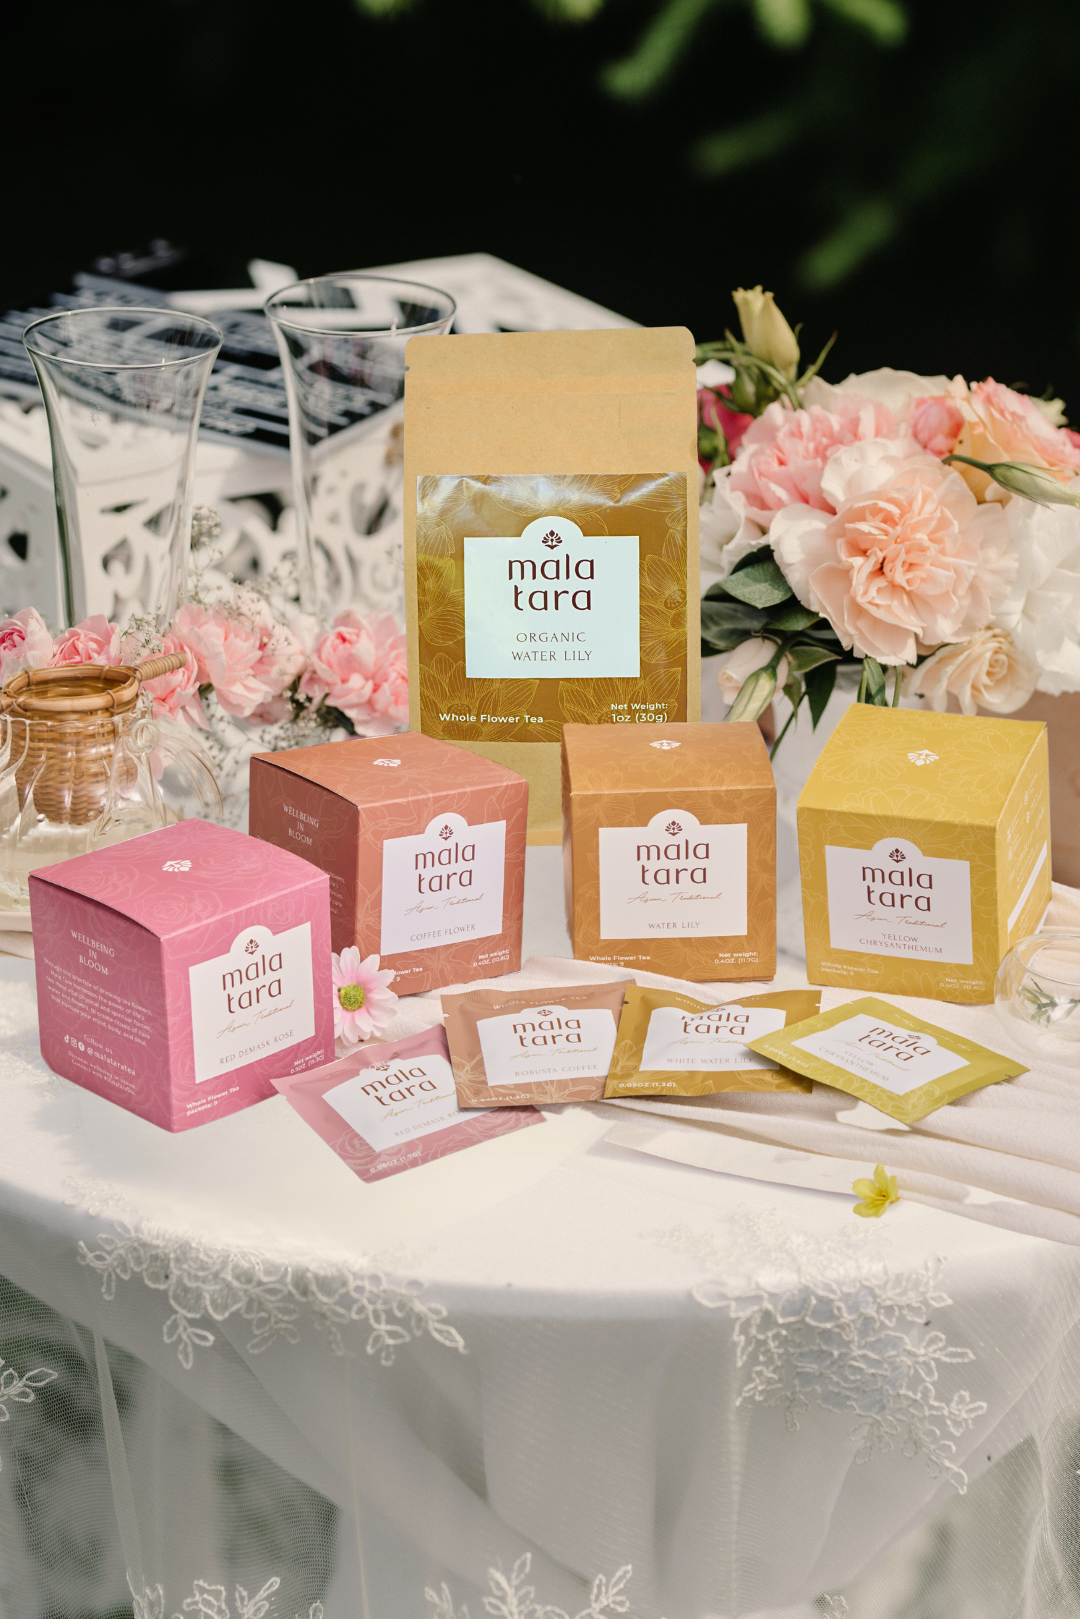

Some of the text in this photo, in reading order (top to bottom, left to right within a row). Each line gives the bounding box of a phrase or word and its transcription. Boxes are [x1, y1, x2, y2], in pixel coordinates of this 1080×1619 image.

[508, 554, 594, 580] mala
[513, 585, 592, 611] tara
[516, 632, 586, 643] ORGANIC
[511, 650, 593, 661] WATER LILY
[631, 702, 668, 711] Weight:
[439, 713, 544, 723] Whole Flower Tea
[611, 712, 668, 723] 1oz (30g)
[283, 803, 319, 828] WELLBEING
[297, 821, 305, 832] IN
[288, 828, 313, 846] BLOOM
[415, 842, 476, 870] mala
[636, 838, 710, 862] mala
[418, 869, 473, 894] tara
[641, 864, 707, 886] tara
[862, 866, 933, 890] mala
[867, 885, 931, 912] tara
[410, 924, 476, 942] COFFEE FLOWER
[681, 921, 701, 929] LILY
[70, 929, 115, 958] WELLBEING
[859, 938, 943, 954] CHRYSANTHEMUM
[881, 932, 919, 943] YELLOW
[88, 948, 98, 960] IN
[490, 949, 510, 957] weight:
[79, 954, 108, 976] BLOOM
[222, 952, 283, 992] mala
[393, 968, 412, 976] lower
[821, 961, 842, 969] Whole
[227, 978, 282, 1014] tara
[512, 1017, 581, 1034] mala
[683, 1021, 745, 1036] tara
[83, 1034, 113, 1055] Follow us
[219, 1029, 295, 1066] RED DEMASK ROSE
[519, 1032, 582, 1048] tara
[858, 1033, 915, 1062] tara
[868, 1027, 932, 1056] mala
[87, 1047, 136, 1076] @malataratea
[294, 1058, 304, 1067] Net
[666, 1057, 697, 1065] WHITE
[701, 1057, 730, 1065] WATER
[818, 1046, 890, 1082] CHRYSANTHEMUM
[843, 1050, 877, 1067] YELLOW
[514, 1064, 599, 1077] ROBUSTA COFFEE
[361, 1067, 427, 1096] mala
[186, 1085, 240, 1109] Whole Flower Tea
[374, 1080, 437, 1106] tara
[186, 1102, 213, 1117] packets:
[394, 1107, 470, 1137] RED DEMASK ROSE
